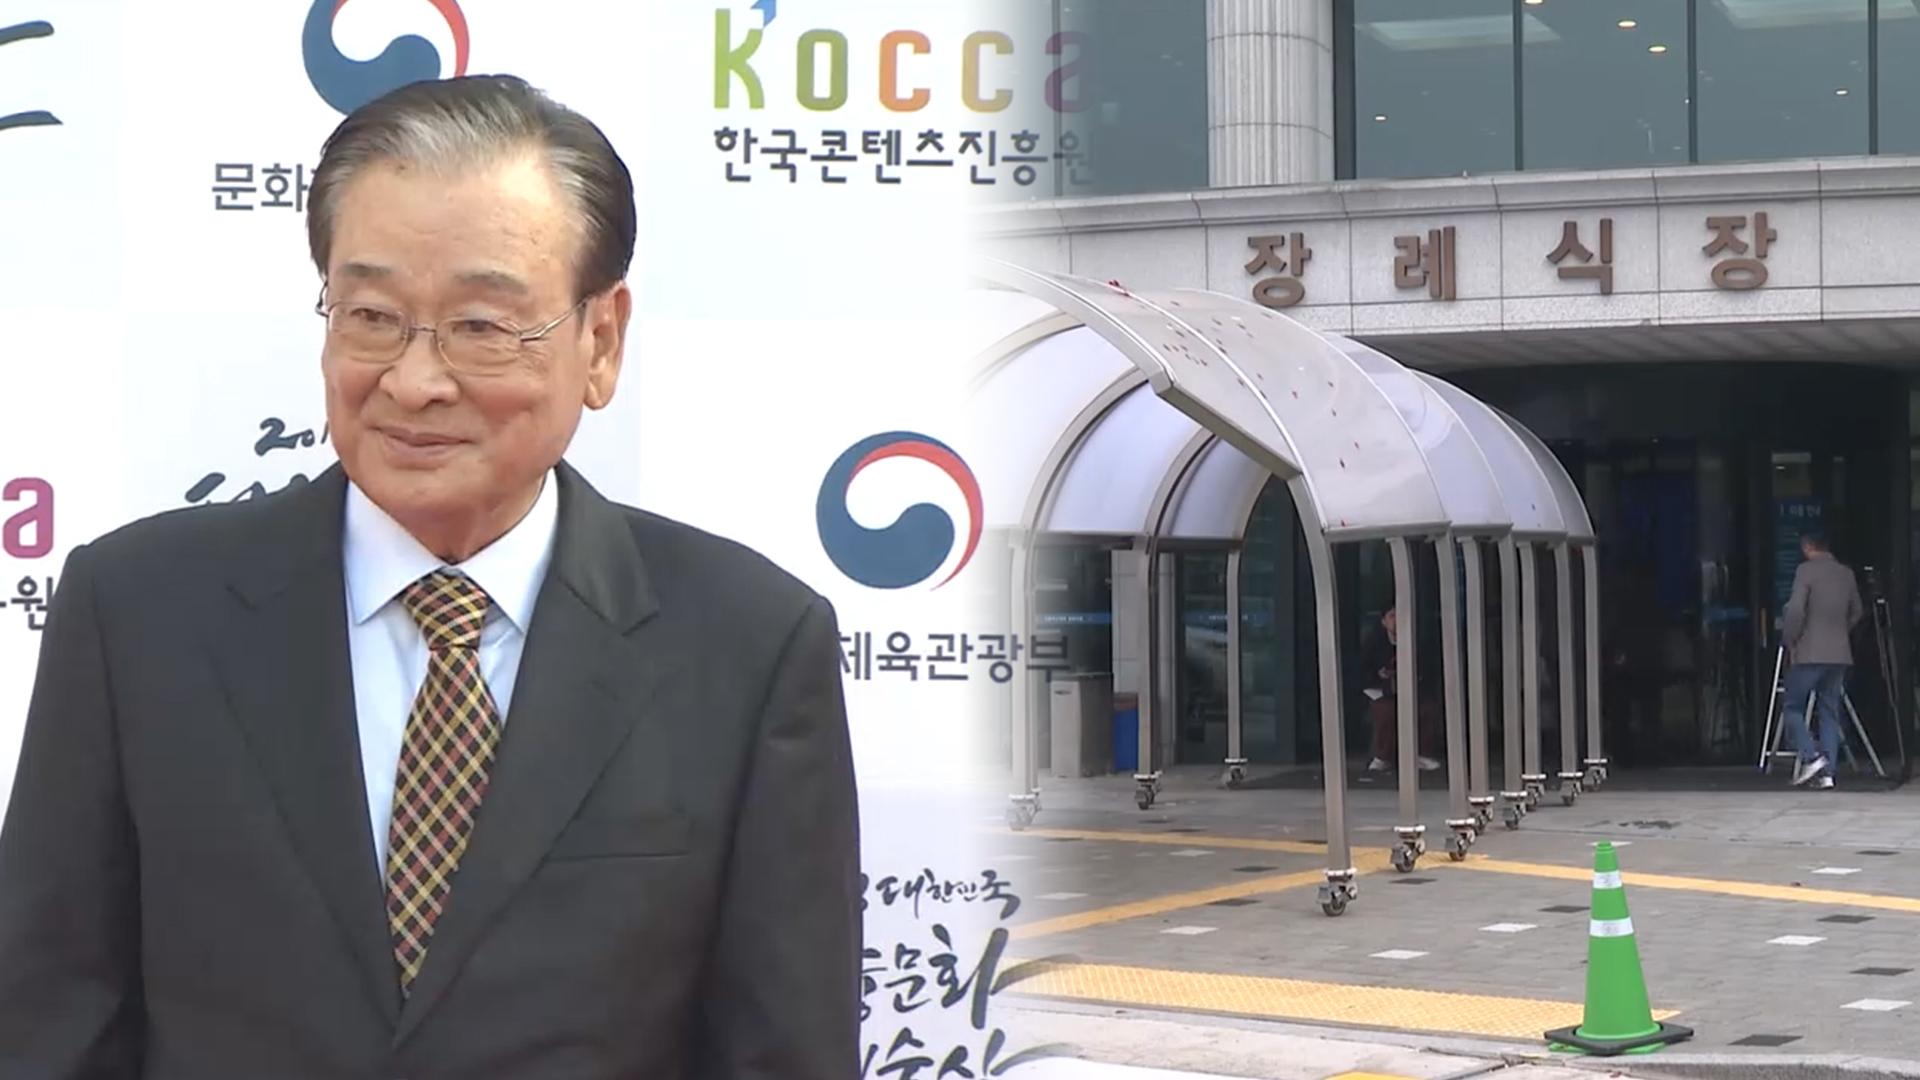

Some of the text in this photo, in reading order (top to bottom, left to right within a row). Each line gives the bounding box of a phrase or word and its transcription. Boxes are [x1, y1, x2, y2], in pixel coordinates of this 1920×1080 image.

[713, 126, 1096, 186] 한국콘텐츠진흥원
[212, 162, 317, 213] 문화
[1244, 211, 1777, 308] 장례식장
[0, 575, 53, 630] 원
[875, 867, 1021, 920] 대한민국
